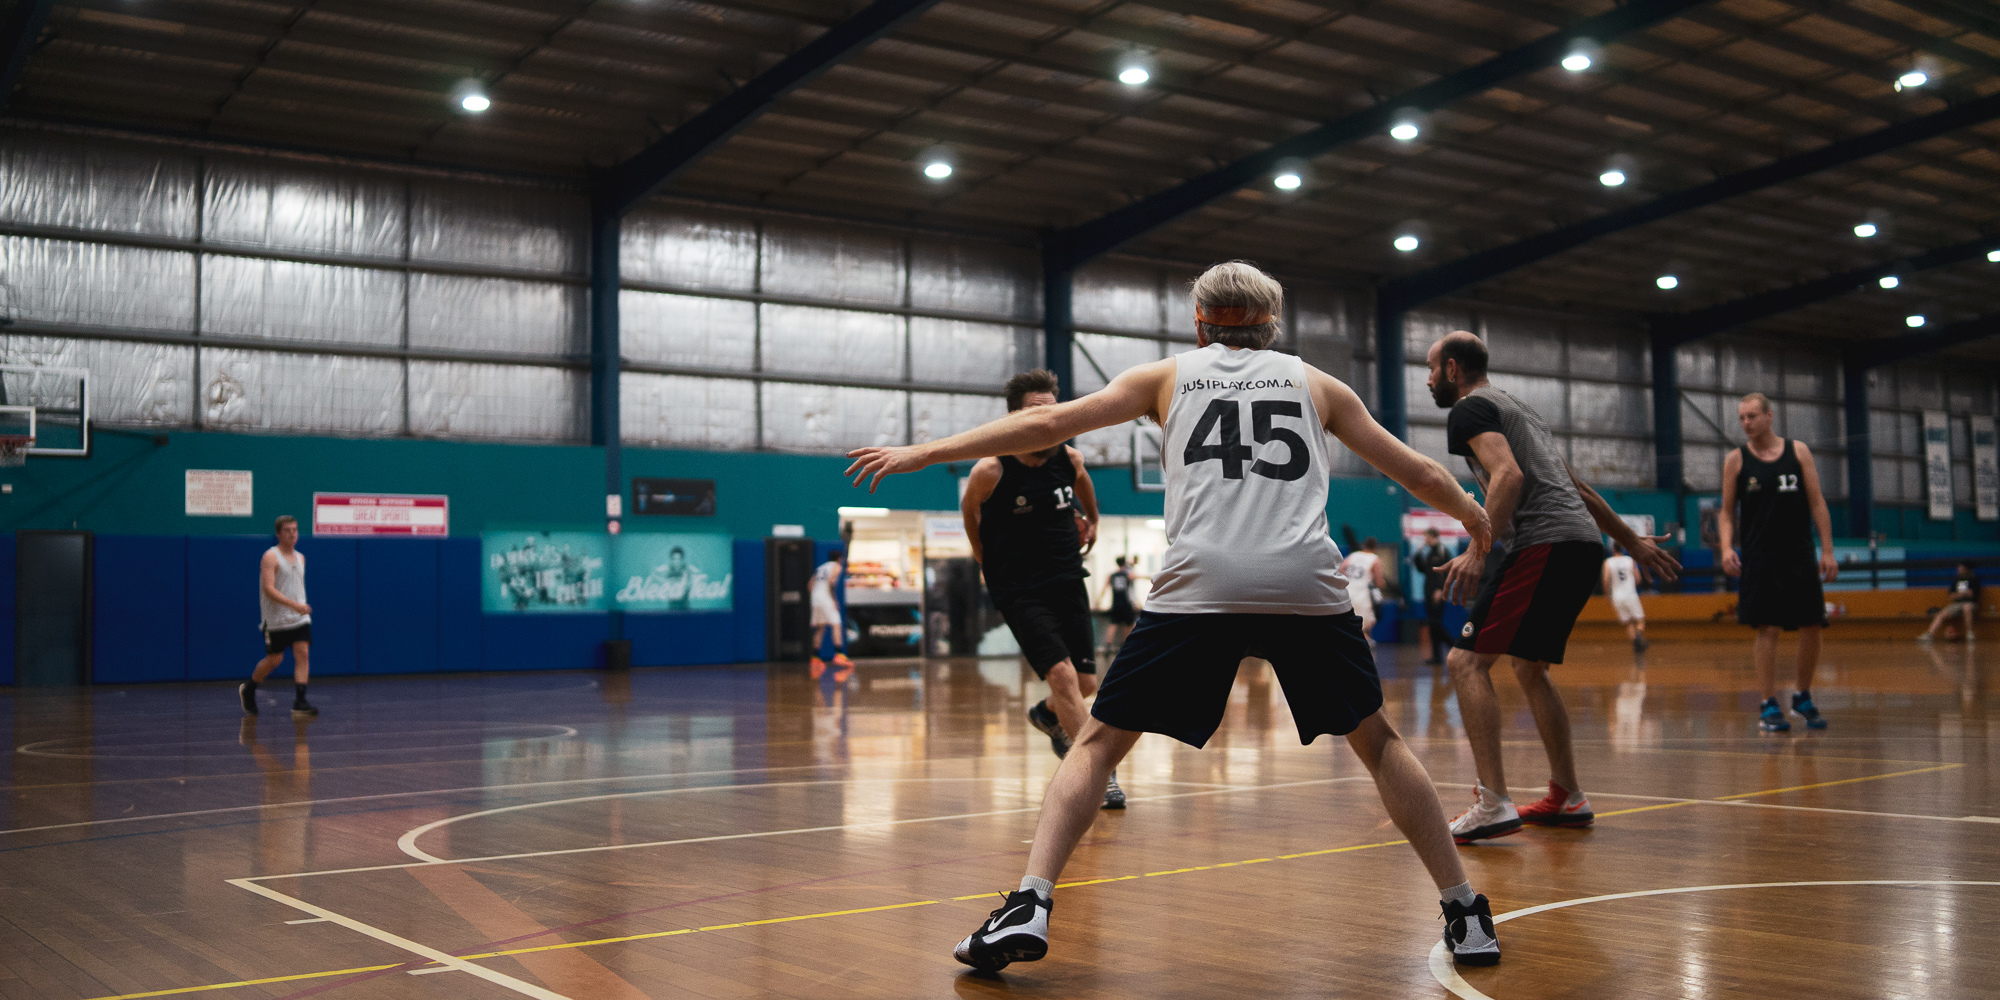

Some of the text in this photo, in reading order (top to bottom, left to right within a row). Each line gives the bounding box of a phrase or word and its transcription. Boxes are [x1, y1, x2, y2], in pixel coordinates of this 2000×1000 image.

[1183, 399, 1311, 482] 45
[1778, 474, 1799, 491] 12
[616, 571, 688, 602] Bleed
